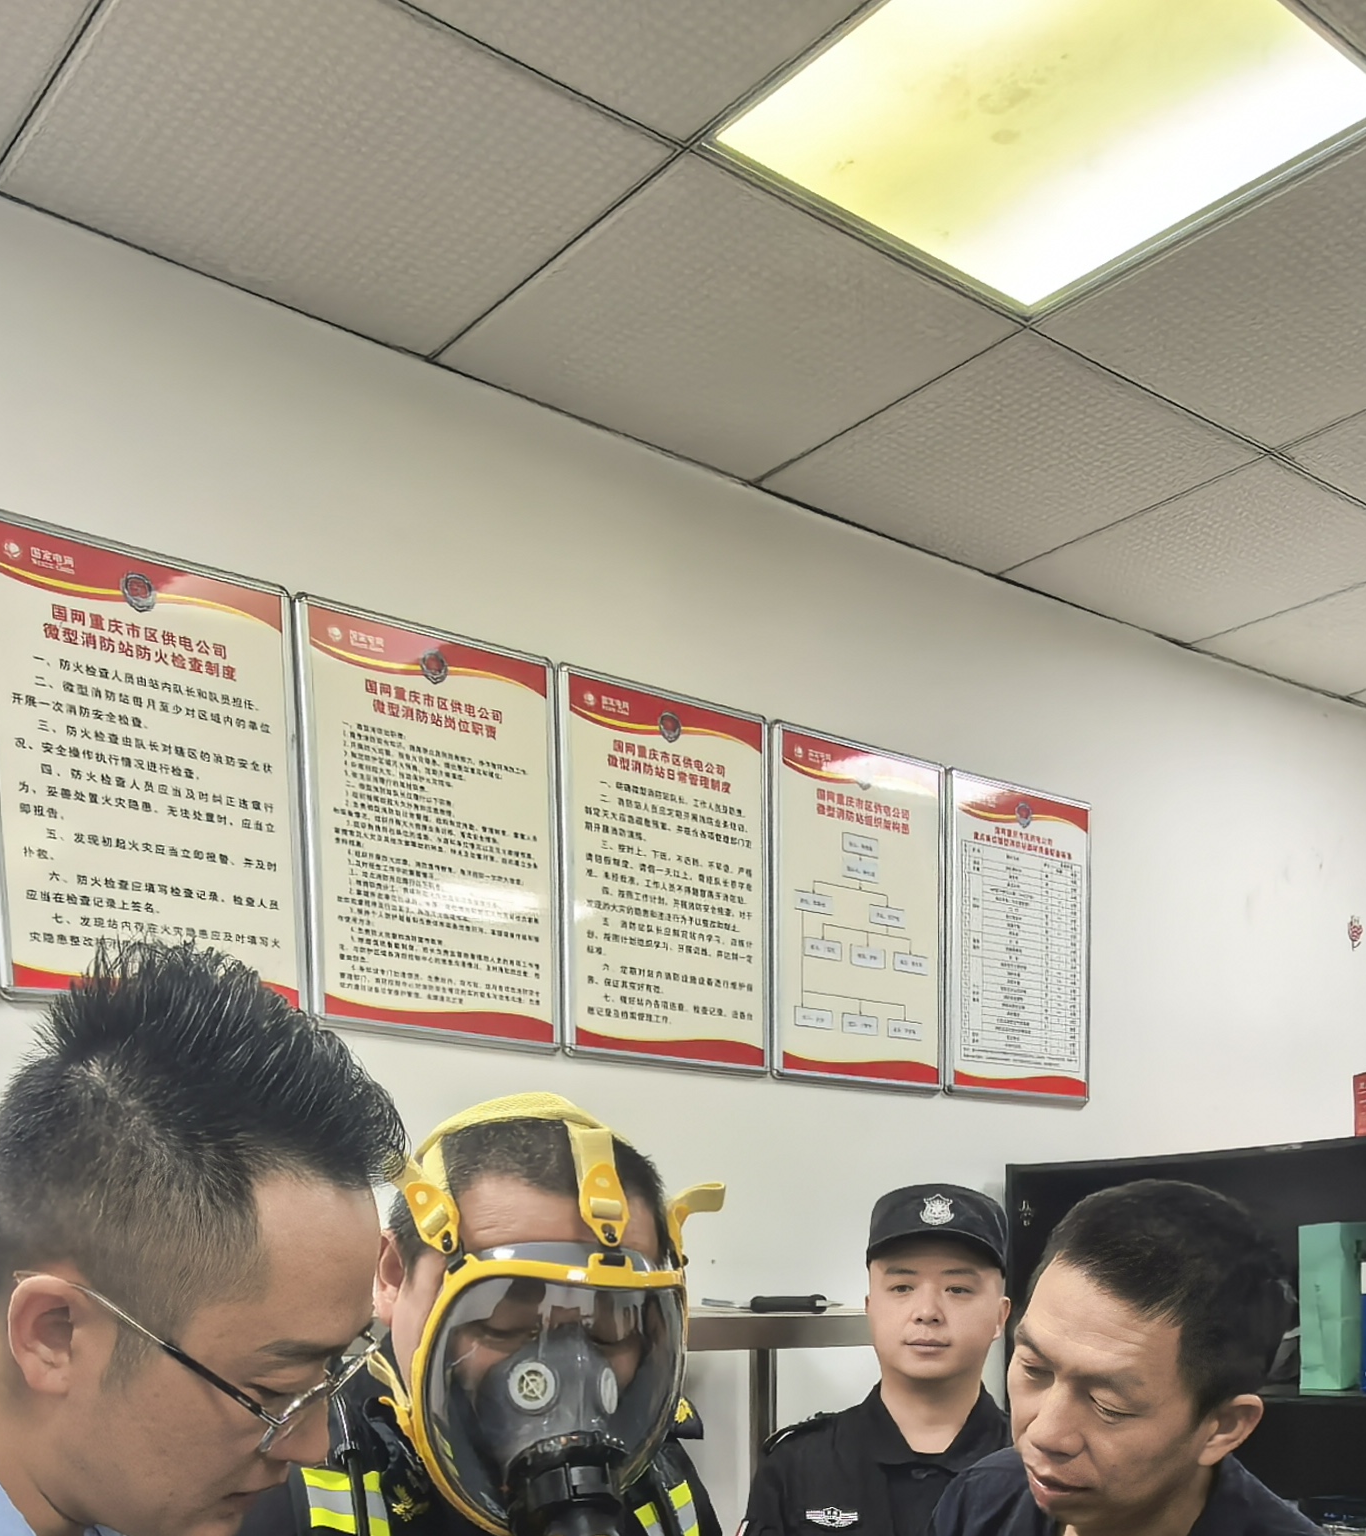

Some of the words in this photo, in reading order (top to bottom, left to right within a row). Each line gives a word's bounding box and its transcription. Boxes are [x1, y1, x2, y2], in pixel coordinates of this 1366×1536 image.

[42, 622, 236, 681] 微型消防站防火检查制度
[51, 603, 226, 660] 国网重庆市区供电公司
[364, 678, 502, 724] 国网重庆市区供电公司
[372, 698, 496, 740] 微型消防站岗位职责
[606, 753, 730, 794] 微型消防站日常管理制度
[612, 738, 725, 777] 国网重庆市区供电公司
